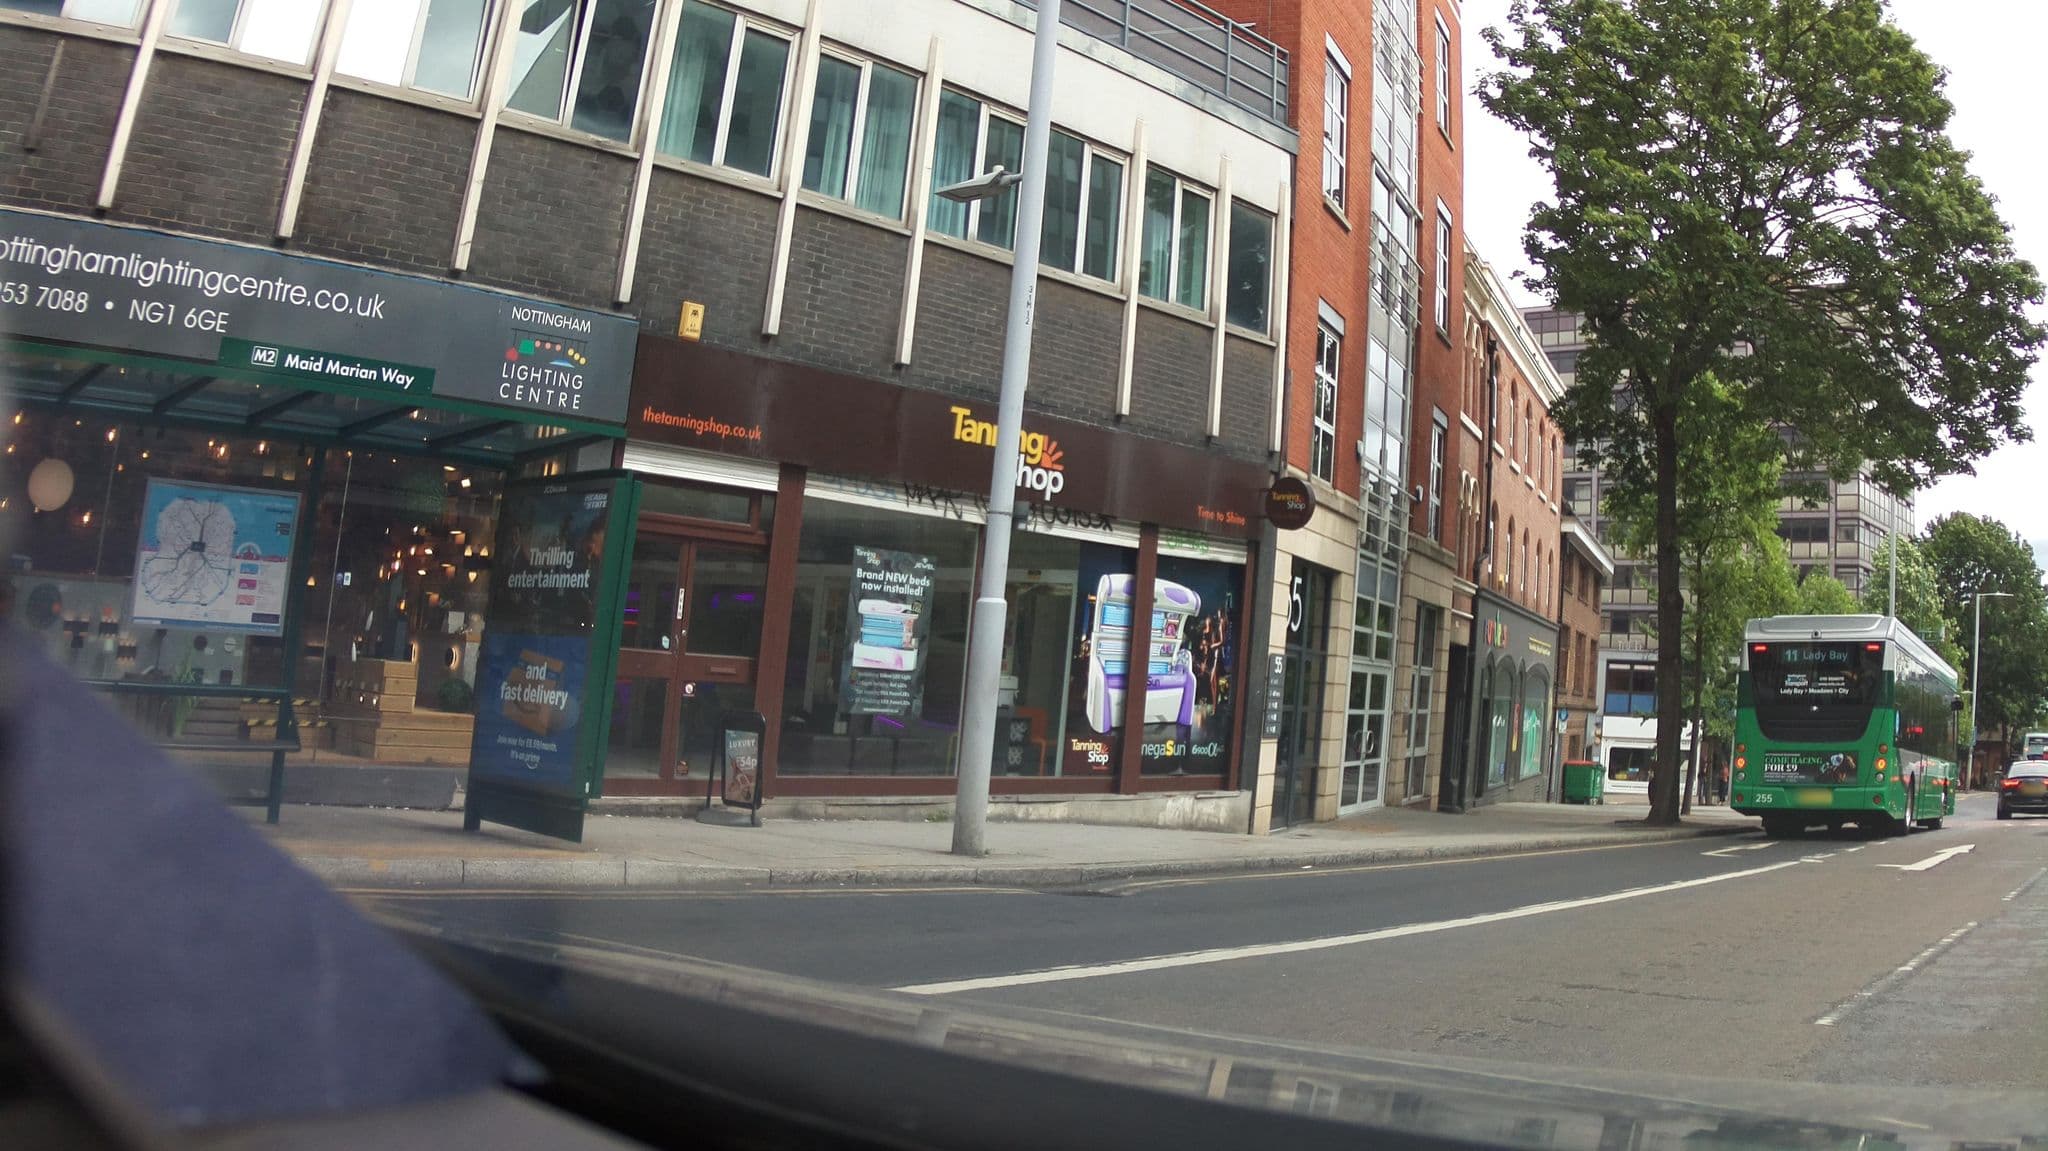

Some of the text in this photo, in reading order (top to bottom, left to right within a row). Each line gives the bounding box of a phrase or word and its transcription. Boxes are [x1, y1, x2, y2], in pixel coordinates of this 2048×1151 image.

[0, 281, 89, 313] 53 7088
[129, 299, 230, 333] NG1 6GE
[511, 306, 591, 333] NOTTINGHAM
[254, 348, 415, 390] M2 Maid Marian Way
[502, 362, 584, 390] LIGHTING
[500, 383, 581, 409] CENTRE
[643, 406, 761, 440] thetanningshop.co.uk
[1016, 453, 1064, 501] hop
[1197, 505, 1214, 519] Time
[1216, 511, 1224, 522] to
[529, 547, 574, 568] Thrilling
[508, 569, 590, 590] entertainment
[856, 568, 930, 586] Brand NEW beds
[861, 582, 924, 596] now installed!
[1785, 649, 1848, 661] 11 Lady Bay
[525, 662, 546, 680] and
[500, 682, 568, 710] fast delivery
[1071, 739, 1102, 753] Tanning
[1088, 751, 1109, 765] Shop
[1755, 793, 1773, 803] 255
